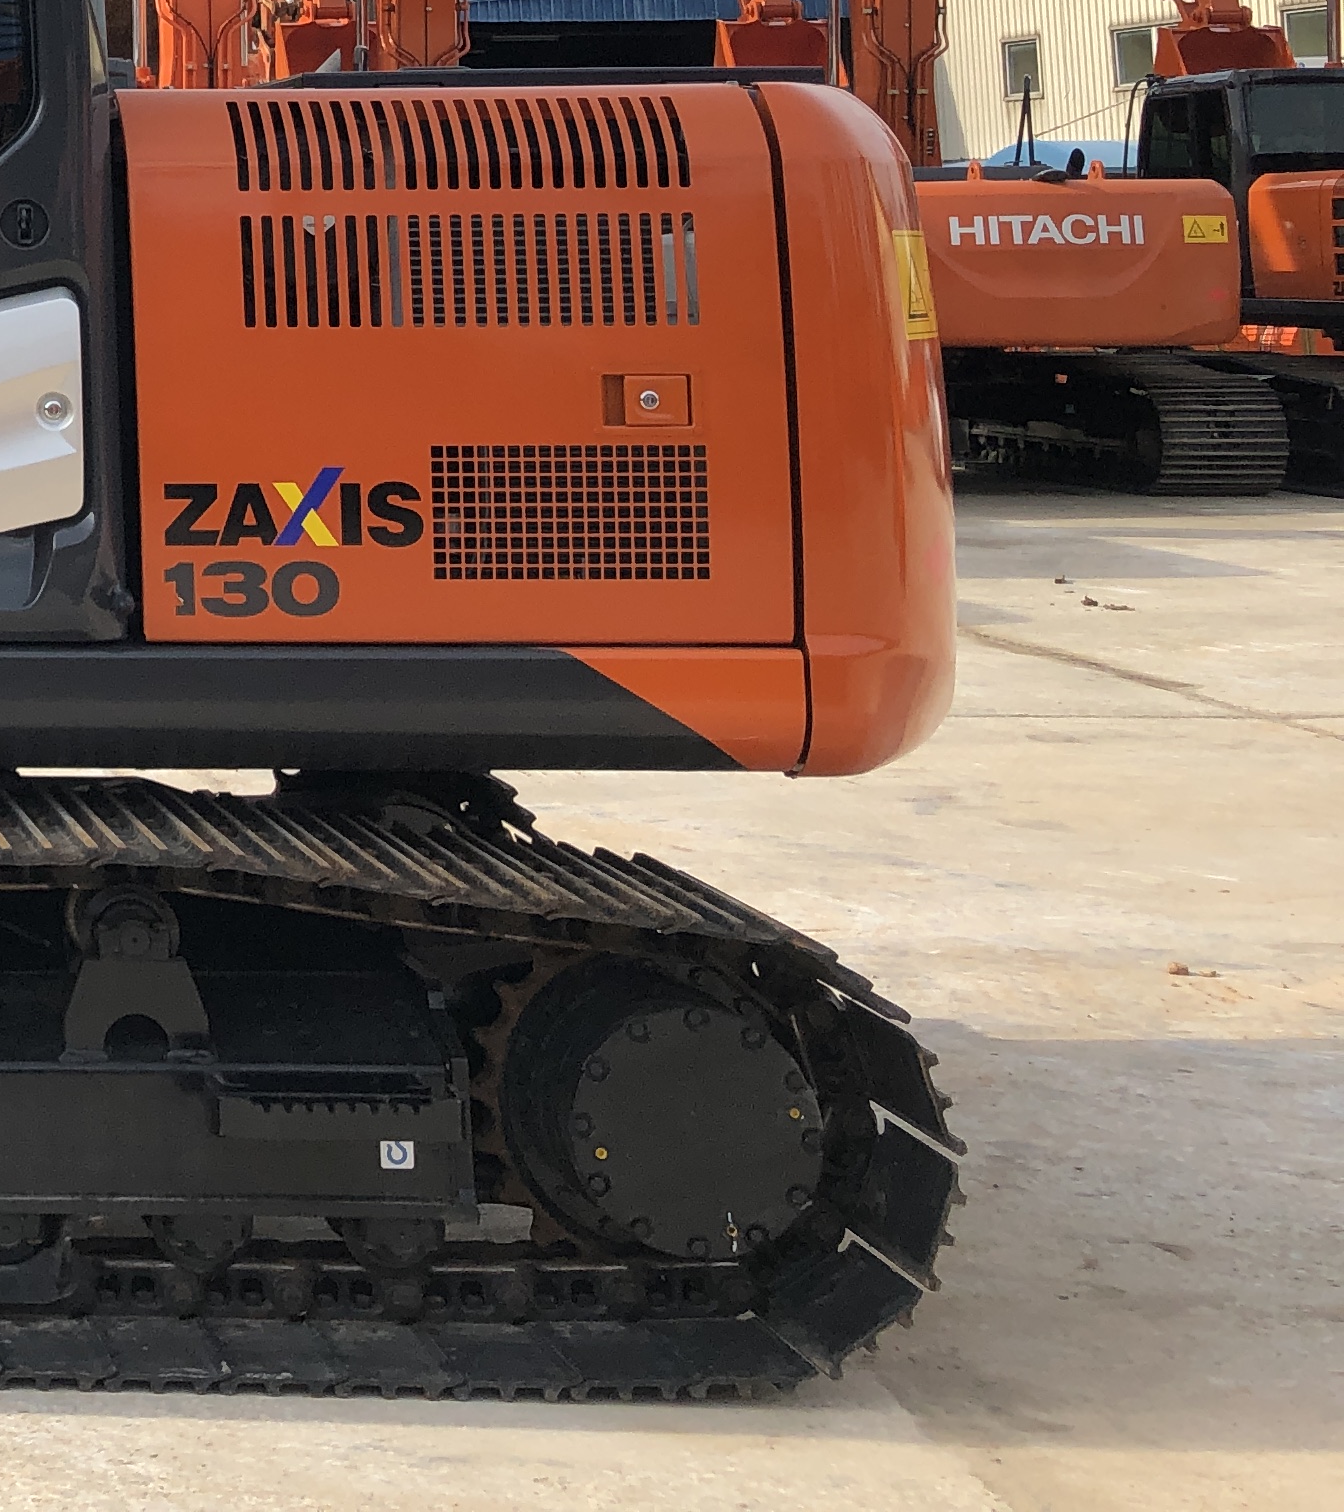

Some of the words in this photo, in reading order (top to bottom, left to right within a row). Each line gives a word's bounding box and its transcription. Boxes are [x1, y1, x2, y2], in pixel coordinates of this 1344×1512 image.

[948, 213, 1146, 246] HITACHI
[163, 466, 425, 548] ZAXIS
[163, 560, 341, 618] 130
